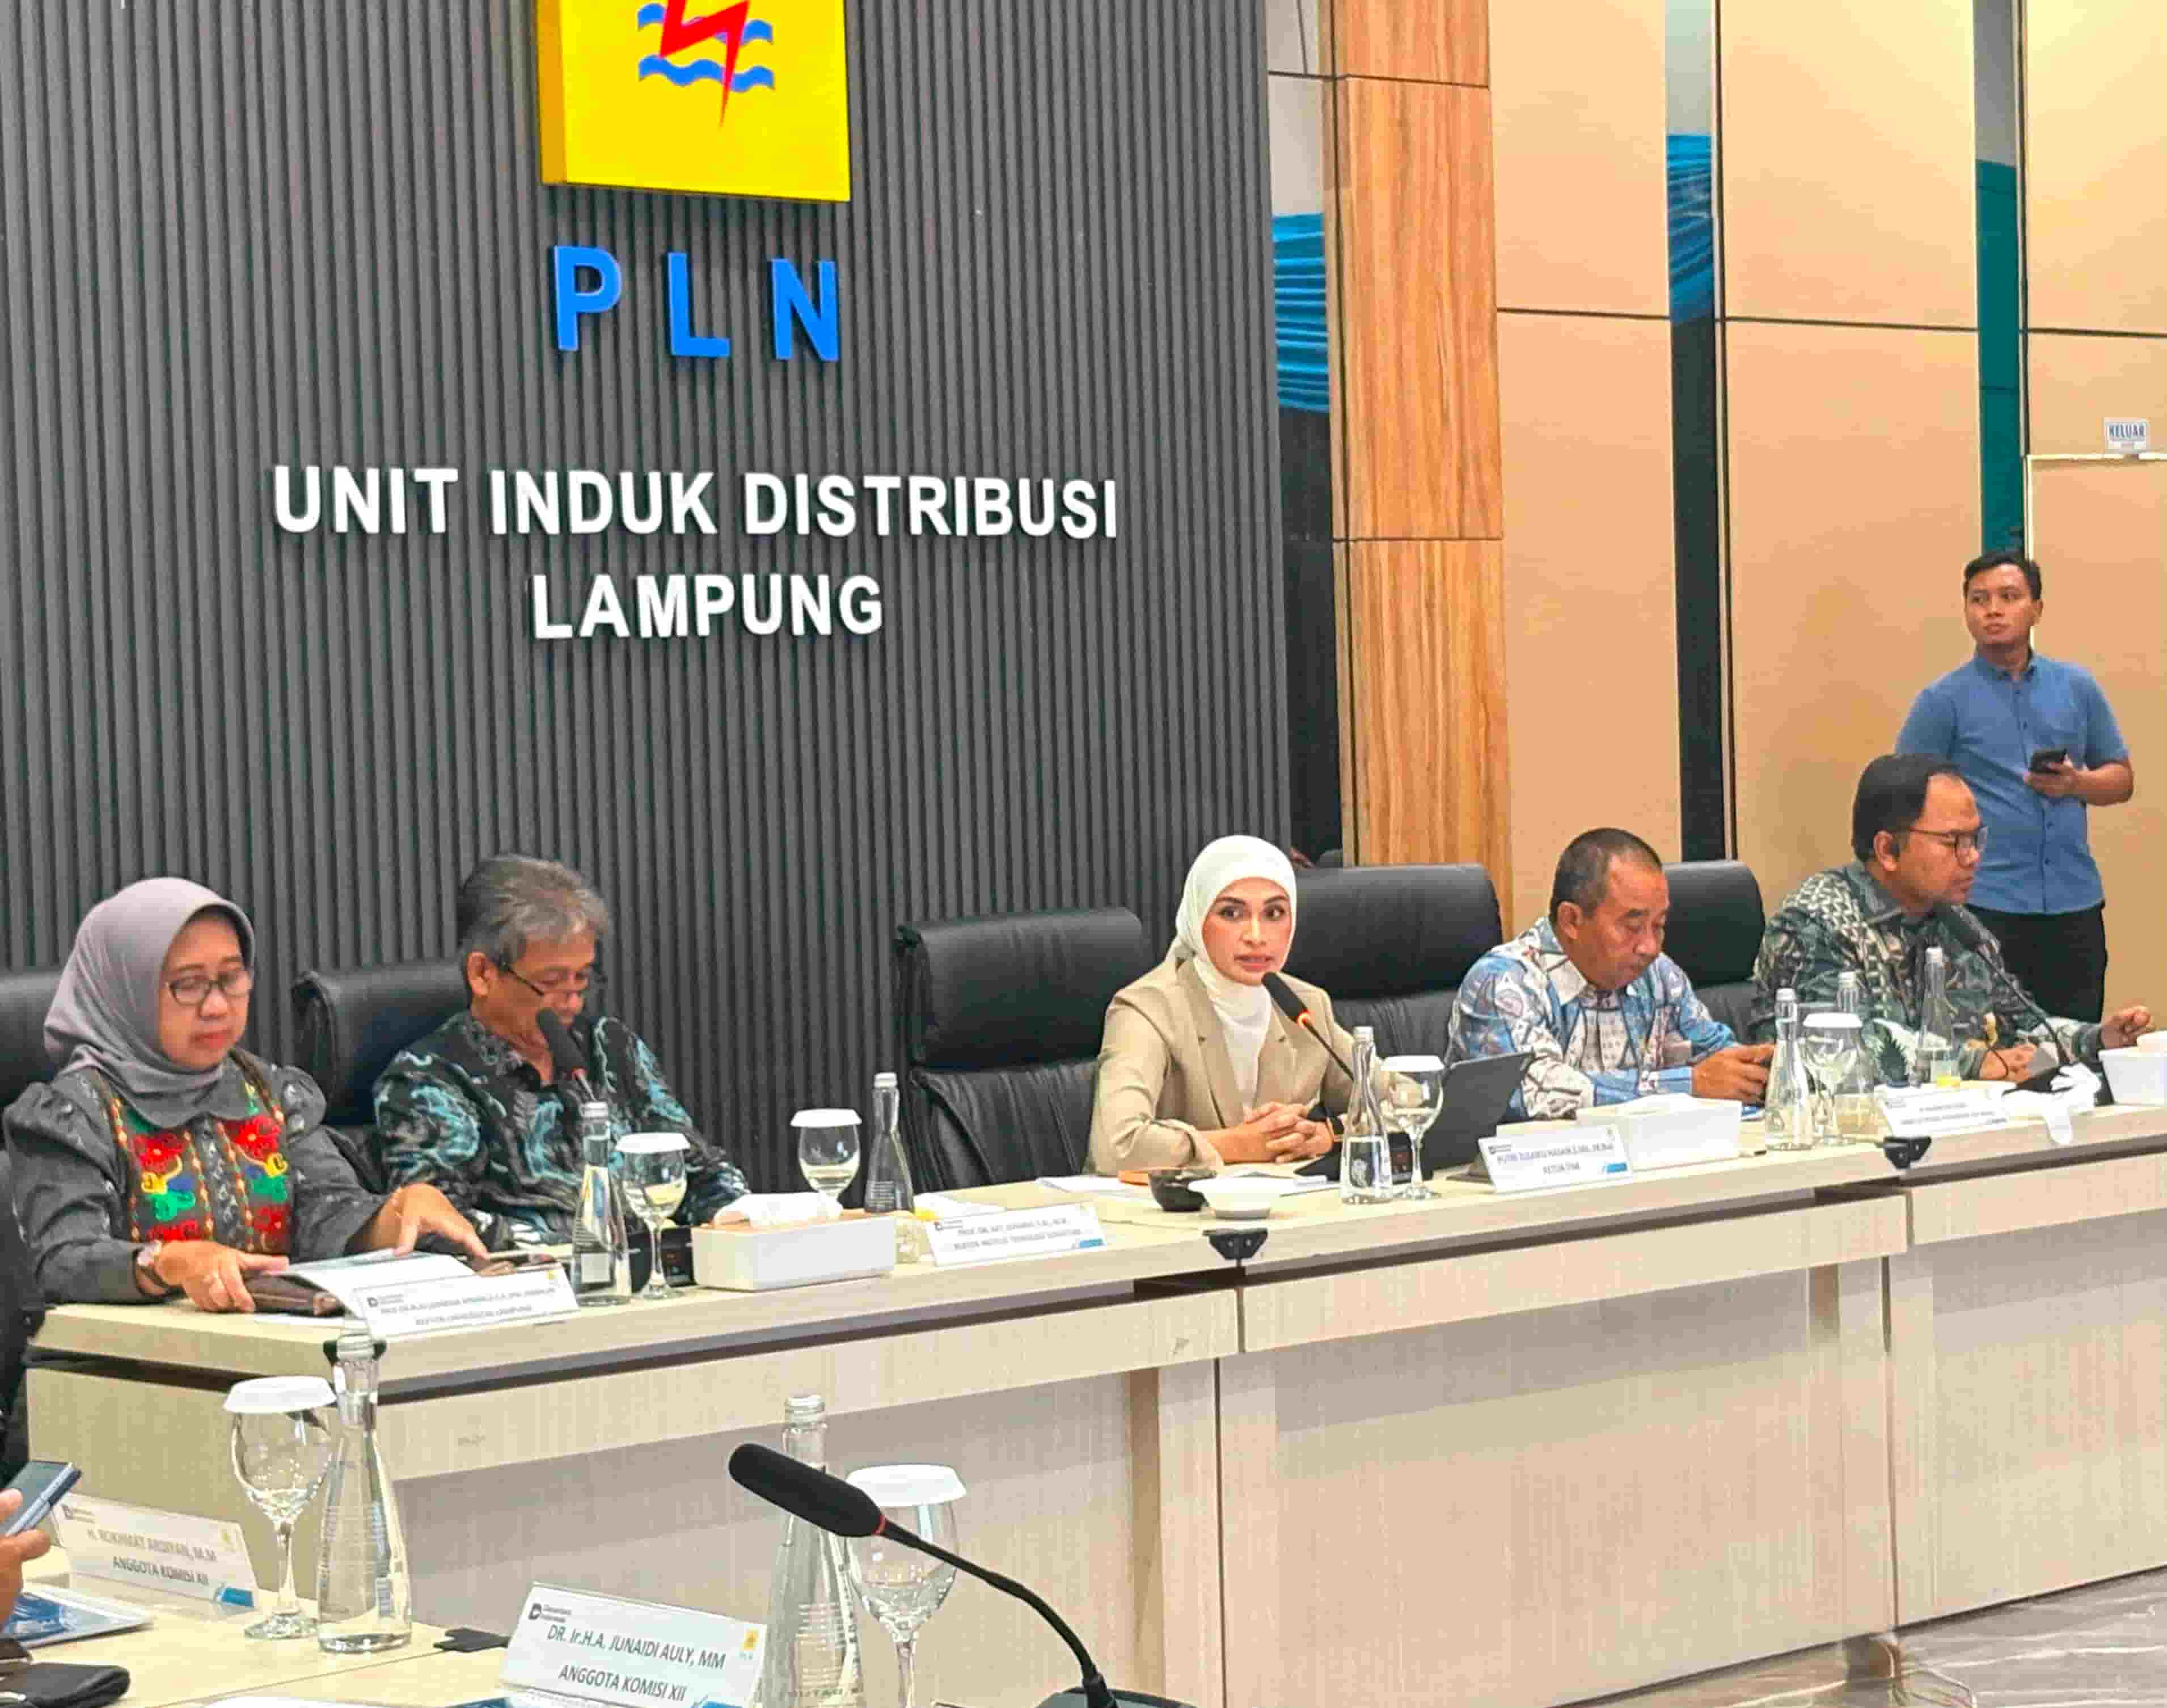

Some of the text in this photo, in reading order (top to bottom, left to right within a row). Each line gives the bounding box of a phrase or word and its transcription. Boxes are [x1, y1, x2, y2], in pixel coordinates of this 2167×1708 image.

[553, 244, 839, 362] PLN
[274, 464, 1117, 539] UNIT INDUK DISTRIBUSI
[532, 573, 882, 639] LAMPUNG
[547, 1624, 566, 1642] DR.
[608, 1635, 660, 1658] JUNAIDI
[659, 1643, 695, 1667] AULY,
[698, 1649, 726, 1669] MM
[557, 1664, 687, 1701] ANGGOTA KOMISI XII
